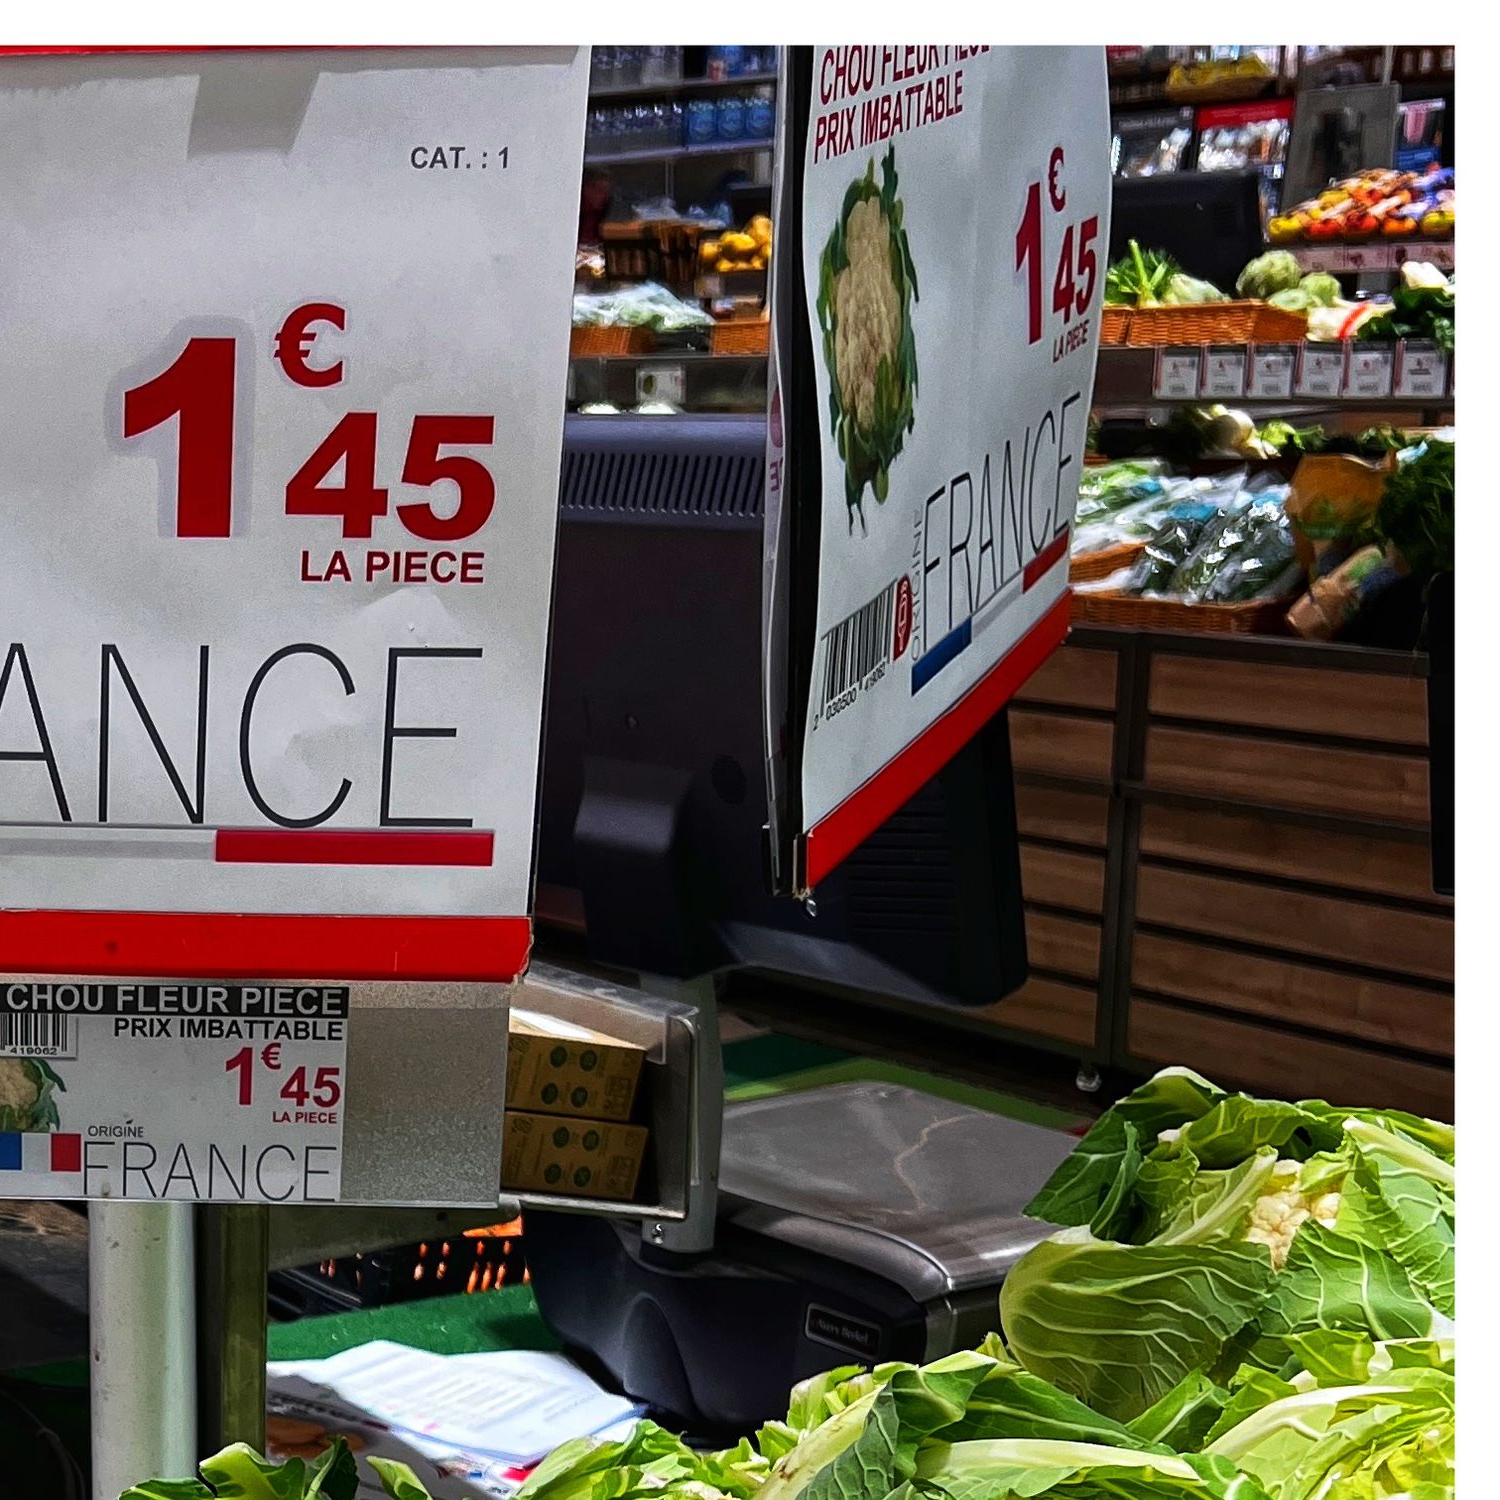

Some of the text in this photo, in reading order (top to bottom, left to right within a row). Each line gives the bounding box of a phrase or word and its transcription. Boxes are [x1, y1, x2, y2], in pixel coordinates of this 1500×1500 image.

[820, 45, 877, 105] CHOU
[814, 70, 963, 164] PRIX IMBATTABLE
[410, 146, 472, 169] CAT.
[497, 147, 510, 169] 1
[1015, 146, 1098, 346] 1 € 45
[1053, 319, 1090, 363] LA PIECE
[124, 303, 495, 541] 1 € 45
[924, 391, 1080, 652] FRANCE
[301, 551, 485, 583] LA PIECE
[6, 983, 343, 1016] CHOU FLEUR PIECE
[114, 1018, 343, 1041] PRIX IMBATTABLE
[225, 1043, 341, 1108] 1 € 45
[87, 1125, 144, 1139] ORIGINE
[272, 1111, 337, 1124] LA PIECE
[83, 1141, 338, 1201] FRANCE
